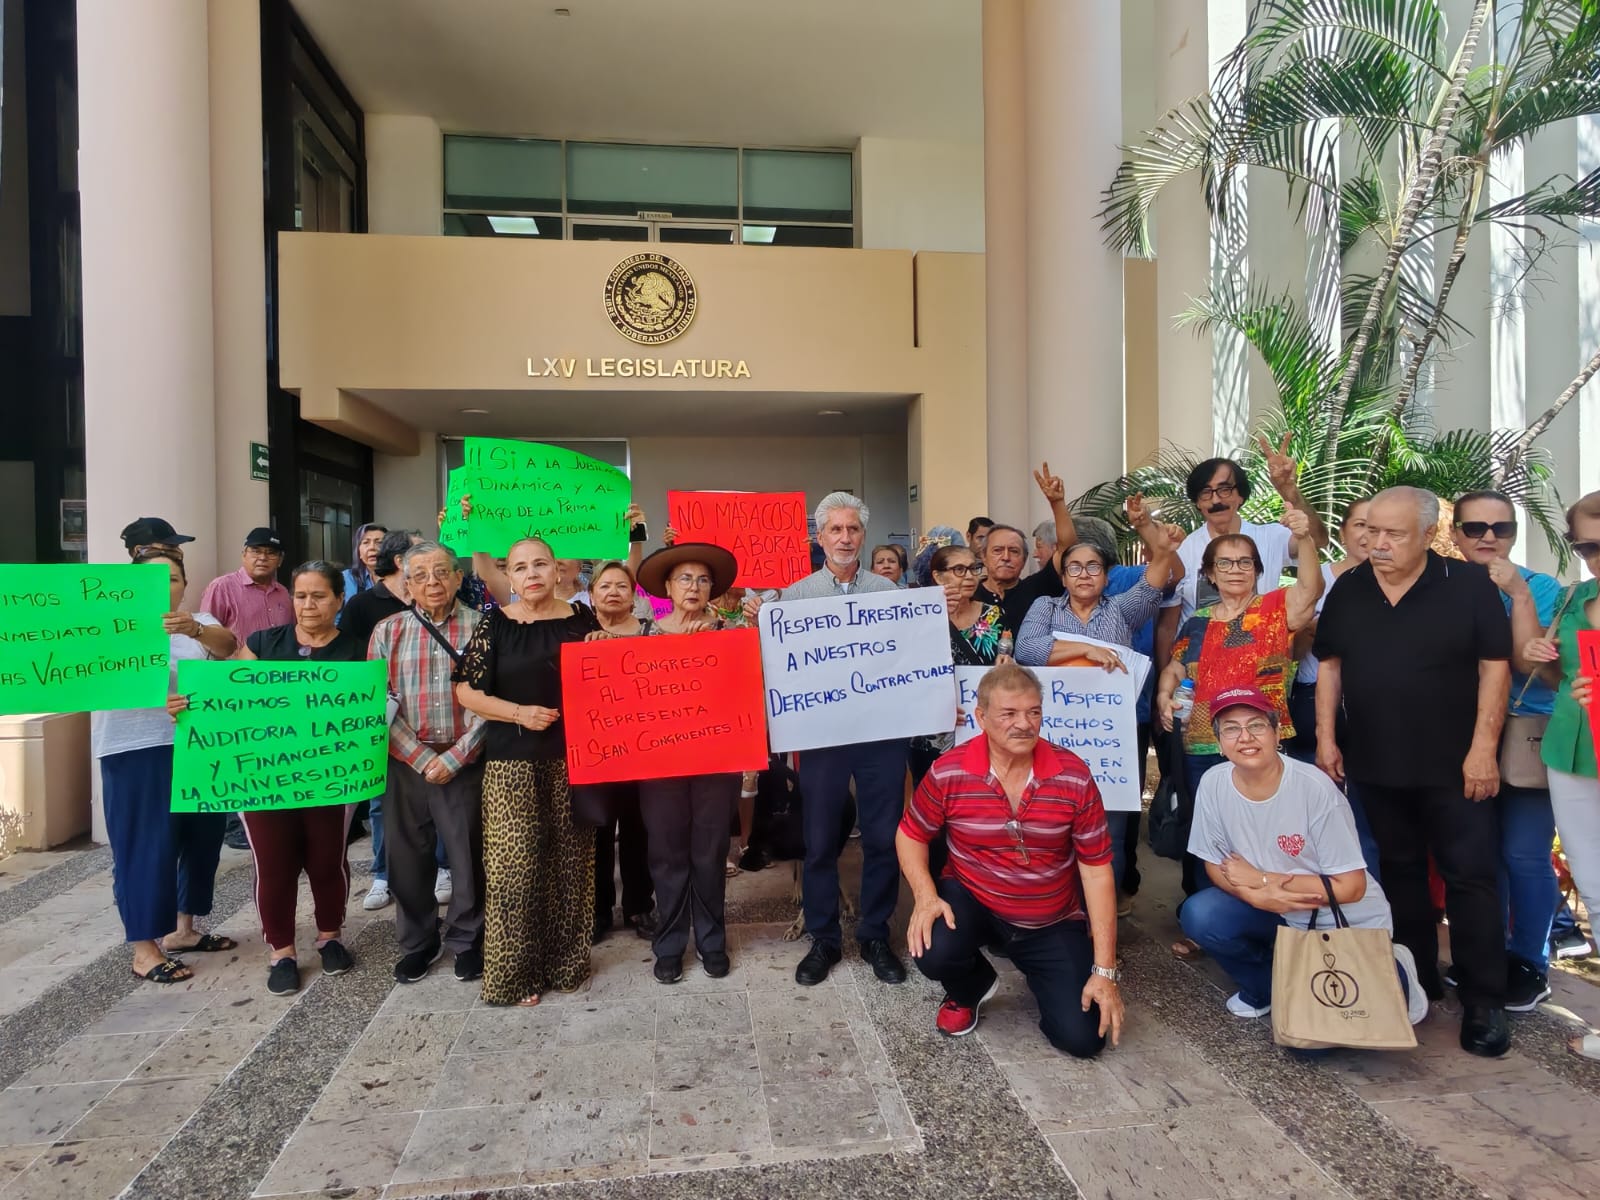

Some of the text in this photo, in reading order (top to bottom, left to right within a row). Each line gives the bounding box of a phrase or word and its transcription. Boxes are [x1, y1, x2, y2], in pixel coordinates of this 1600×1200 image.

[610, 254, 691, 286] CONGRESO DEL ESTADO
[660, 266, 684, 297] MEXICANOS
[605, 293, 616, 318] LIBRE
[622, 326, 665, 342] SOBERANO
[667, 330, 677, 338] DE
[677, 298, 694, 330] SINALOA
[527, 358, 751, 378] LXV LEGISLATURA
[526, 457, 536, 468] A
[545, 457, 560, 469] LA
[594, 484, 617, 494] AL
[477, 505, 512, 521] PAGO
[517, 507, 535, 517] DE
[539, 505, 554, 517] LA
[557, 497, 596, 515] PRIMA
[678, 501, 705, 532] NO
[523, 524, 602, 538] VACACIONAL
[742, 558, 776, 579] LAS
[80, 577, 134, 602] PAGO
[113, 618, 137, 634] DE
[770, 607, 841, 643] RESPETO
[32, 651, 168, 686] VACACIONALES
[581, 650, 718, 681] EL CONGRESO
[787, 639, 897, 672] A NUESTROS
[229, 666, 338, 685] GOBIERNO
[600, 676, 703, 705] AL PUEBLO
[769, 664, 955, 717] DERECHOS CONTRACTUALES
[185, 685, 376, 712] EXIGIMOS HAGAN
[1051, 679, 1122, 709] RESPETO
[188, 714, 388, 751] AUDITORIA LABORAL
[586, 705, 709, 732] REPRESENTA
[637, 722, 732, 752] CONGRUENTES
[234, 740, 359, 774] FINANCIERA
[370, 733, 385, 746] EN
[181, 759, 374, 800] LA UNIVERSIDAD
[197, 775, 385, 812] AUTONOMA DE SINALOA
